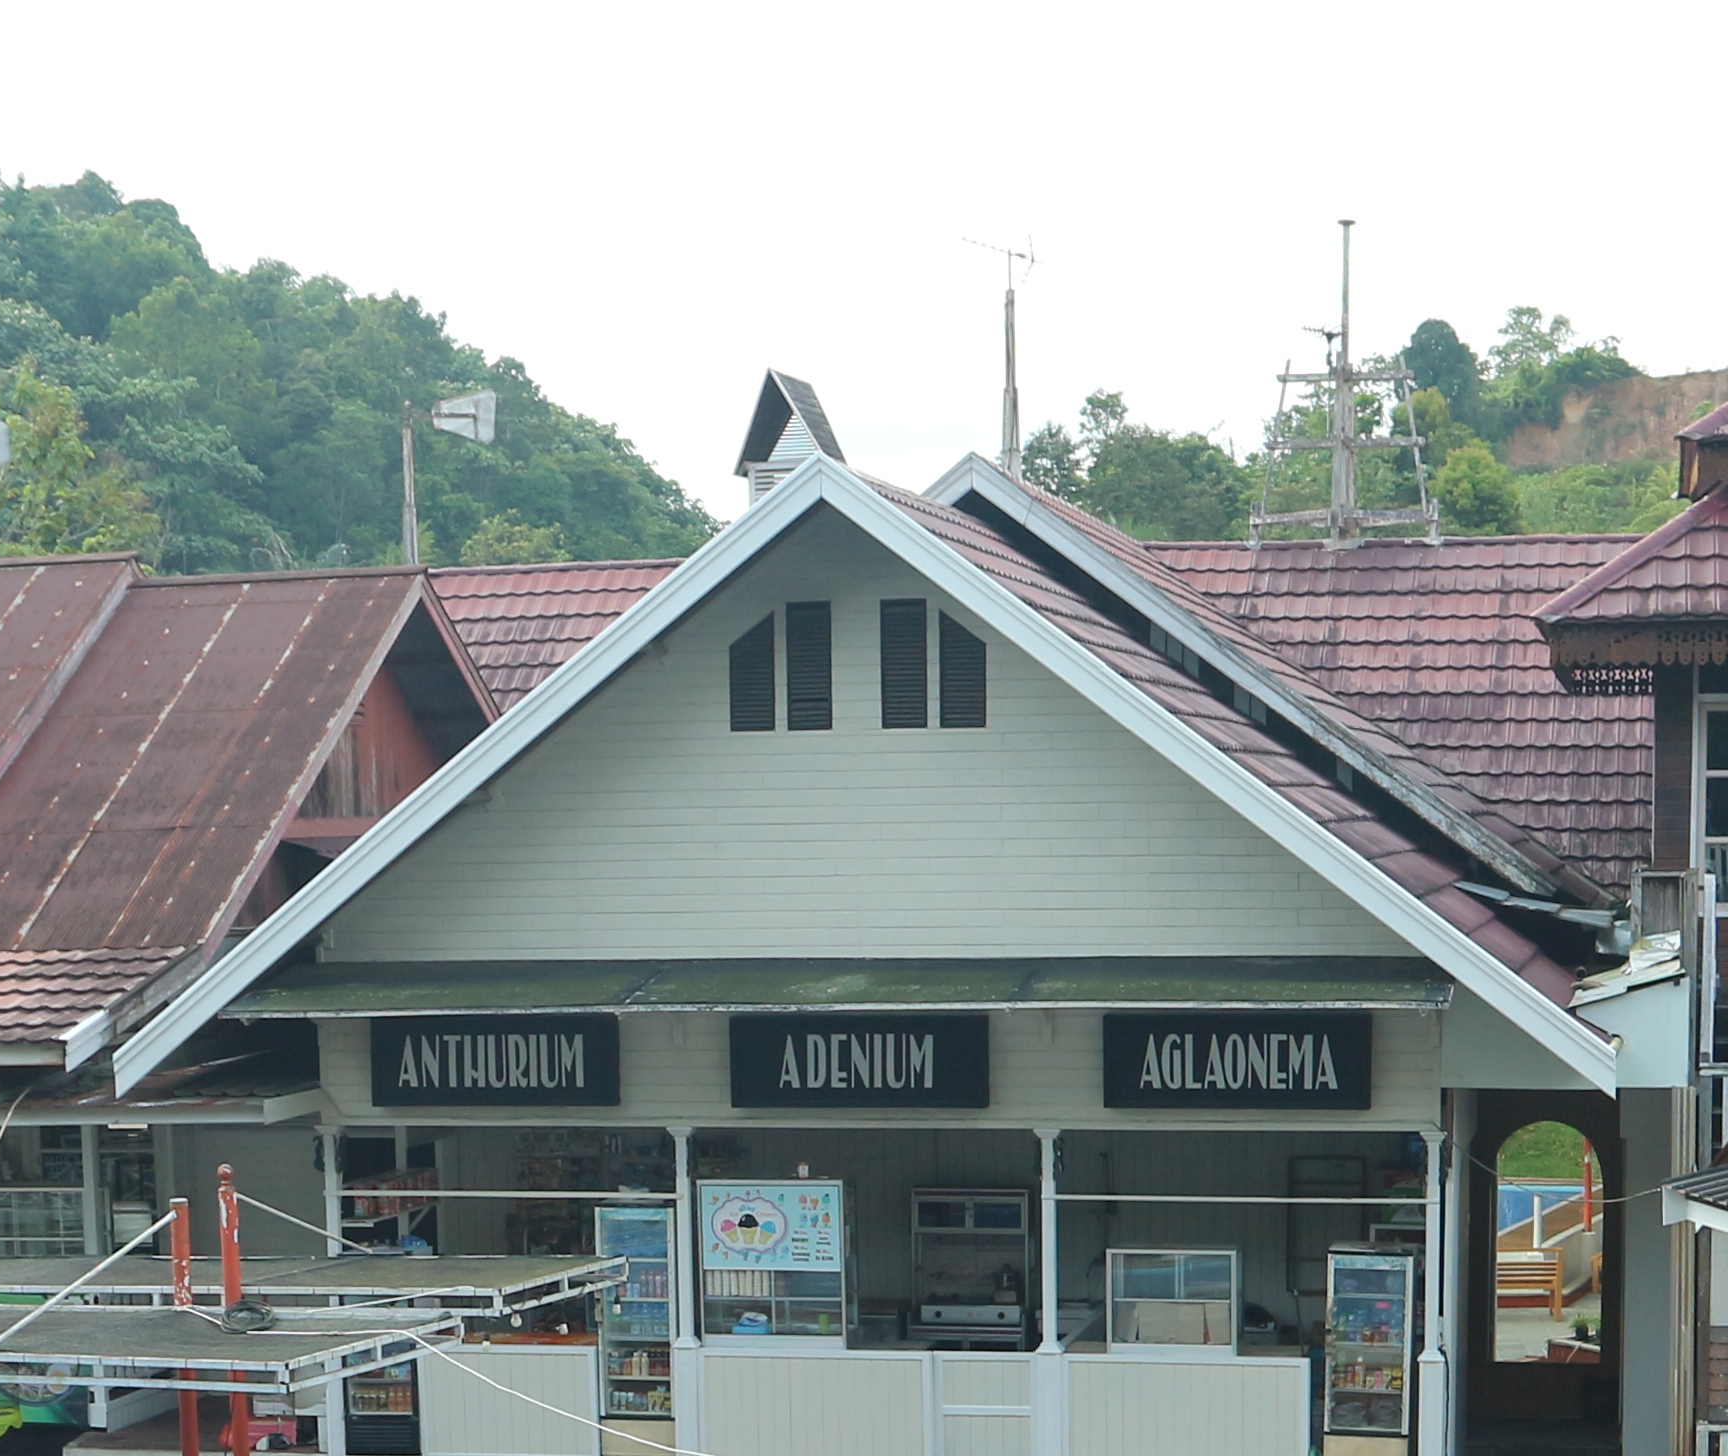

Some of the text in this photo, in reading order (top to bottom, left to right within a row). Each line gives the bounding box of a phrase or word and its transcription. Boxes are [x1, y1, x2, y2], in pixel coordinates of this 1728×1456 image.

[398, 1033, 585, 1089] ANTHURIUM
[779, 1033, 934, 1089] ADENIUM
[1139, 1033, 1339, 1090] AGLAONEMA
